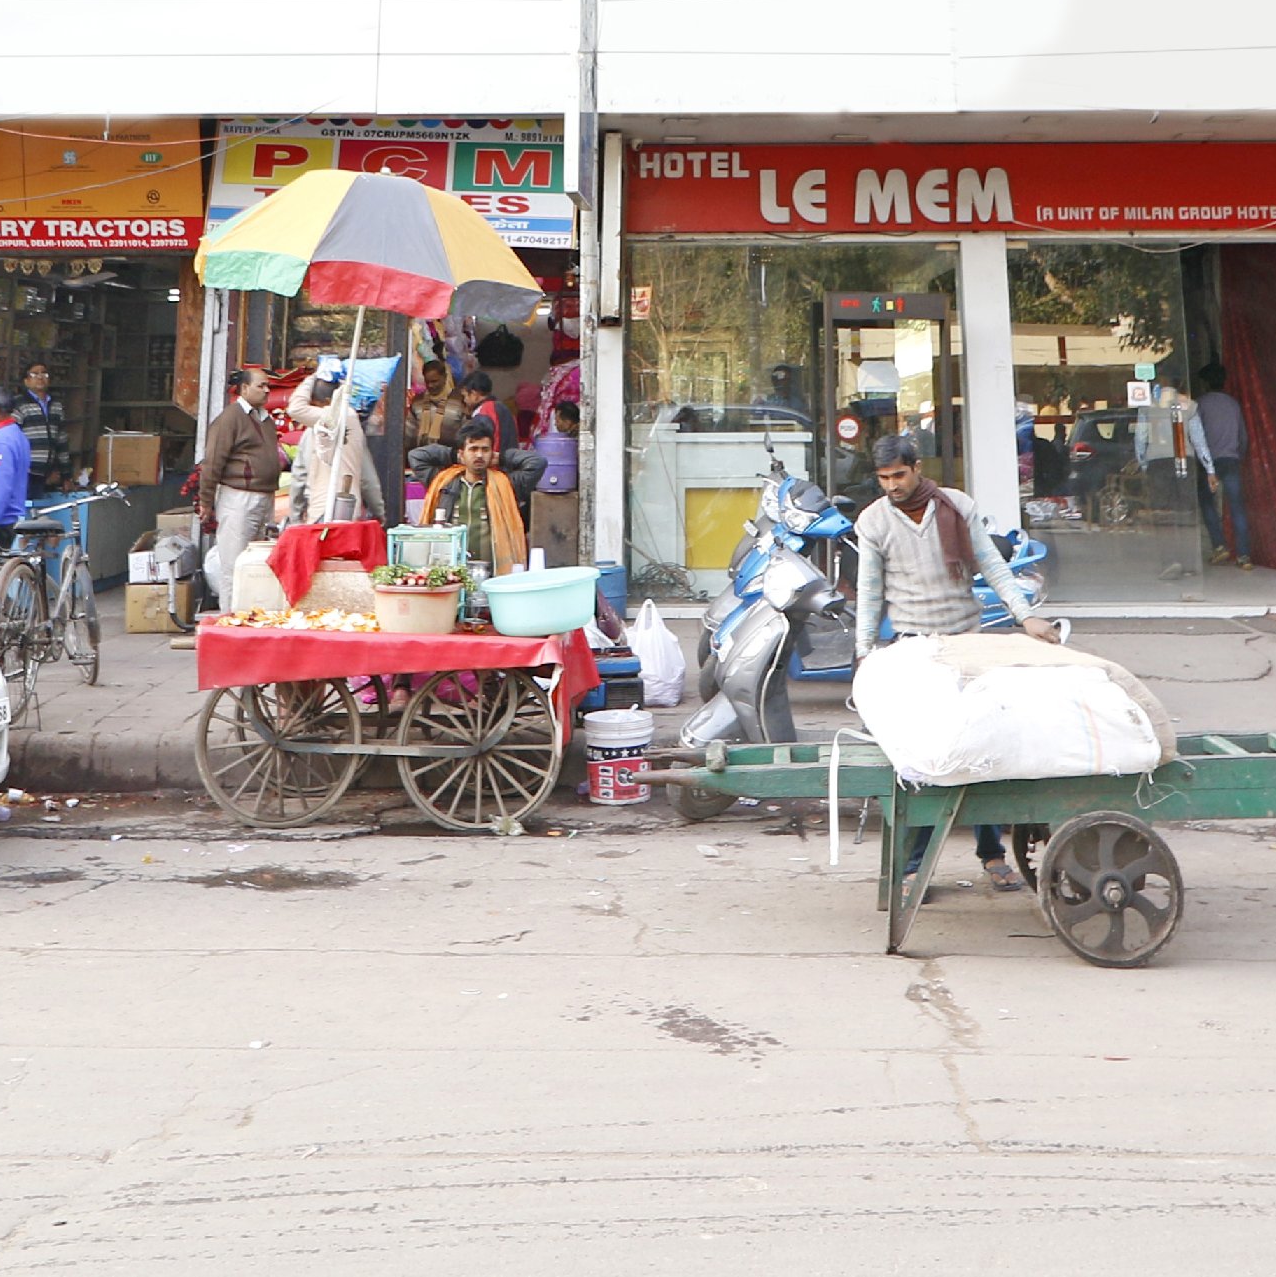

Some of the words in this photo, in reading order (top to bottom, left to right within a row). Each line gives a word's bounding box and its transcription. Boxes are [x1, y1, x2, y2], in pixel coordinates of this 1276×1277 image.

[320, 129, 355, 138] GSTIN
[251, 144, 310, 180] P
[362, 145, 429, 181] C
[473, 148, 553, 189] M
[639, 151, 750, 179] HOTEL
[759, 168, 827, 224] LE
[854, 167, 1015, 224] MEM
[1058, 205, 1094, 221] UNIT
[1099, 205, 1120, 220] OF
[1124, 205, 1174, 221] MILAN
[1178, 205, 1233, 221] GROUP
[43, 219, 186, 237] TRACTORS
[88, 240, 103, 248] TEL
